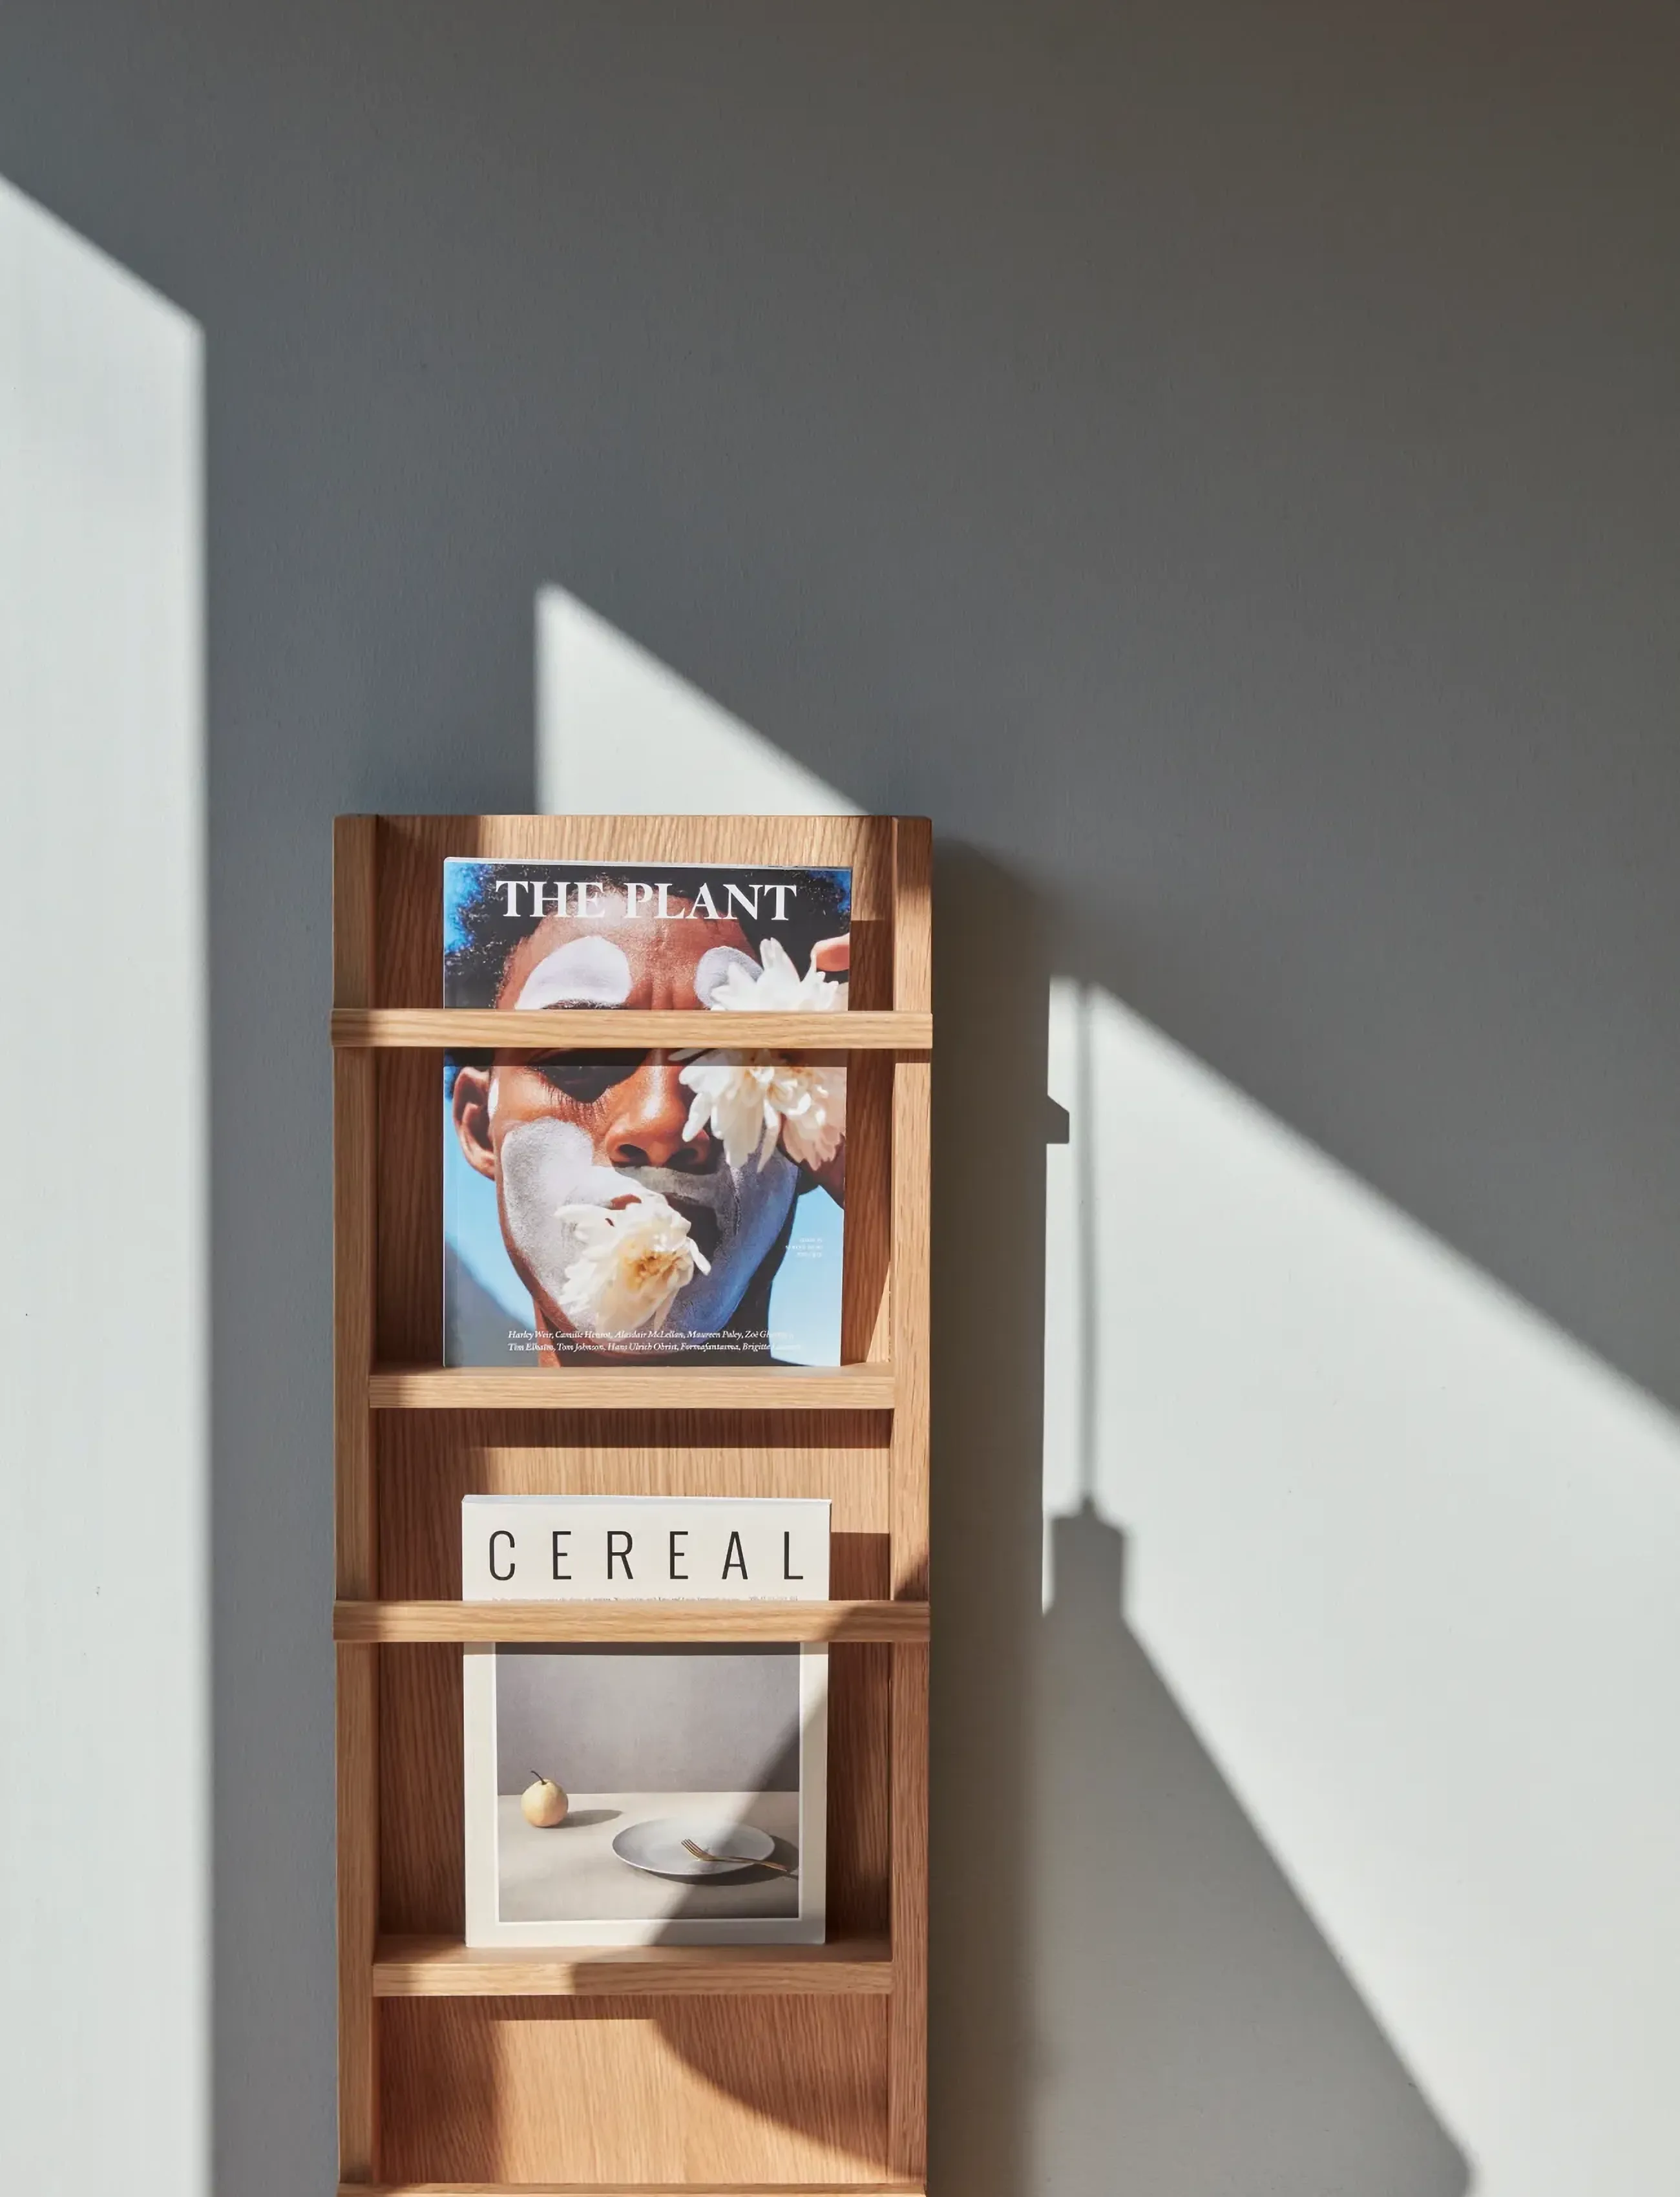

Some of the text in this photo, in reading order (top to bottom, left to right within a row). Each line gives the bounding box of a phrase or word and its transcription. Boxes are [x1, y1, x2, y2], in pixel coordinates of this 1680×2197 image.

[496, 881, 797, 921] THE PLANT
[508, 1330, 534, 1340] Harley
[535, 1330, 554, 1340] Weir,
[687, 1330, 720, 1338] Maureen
[722, 1330, 744, 1340] Paley,
[557, 1343, 573, 1351] Tom
[629, 1343, 652, 1351] Ulrich
[488, 1530, 804, 1581] CEREAL
